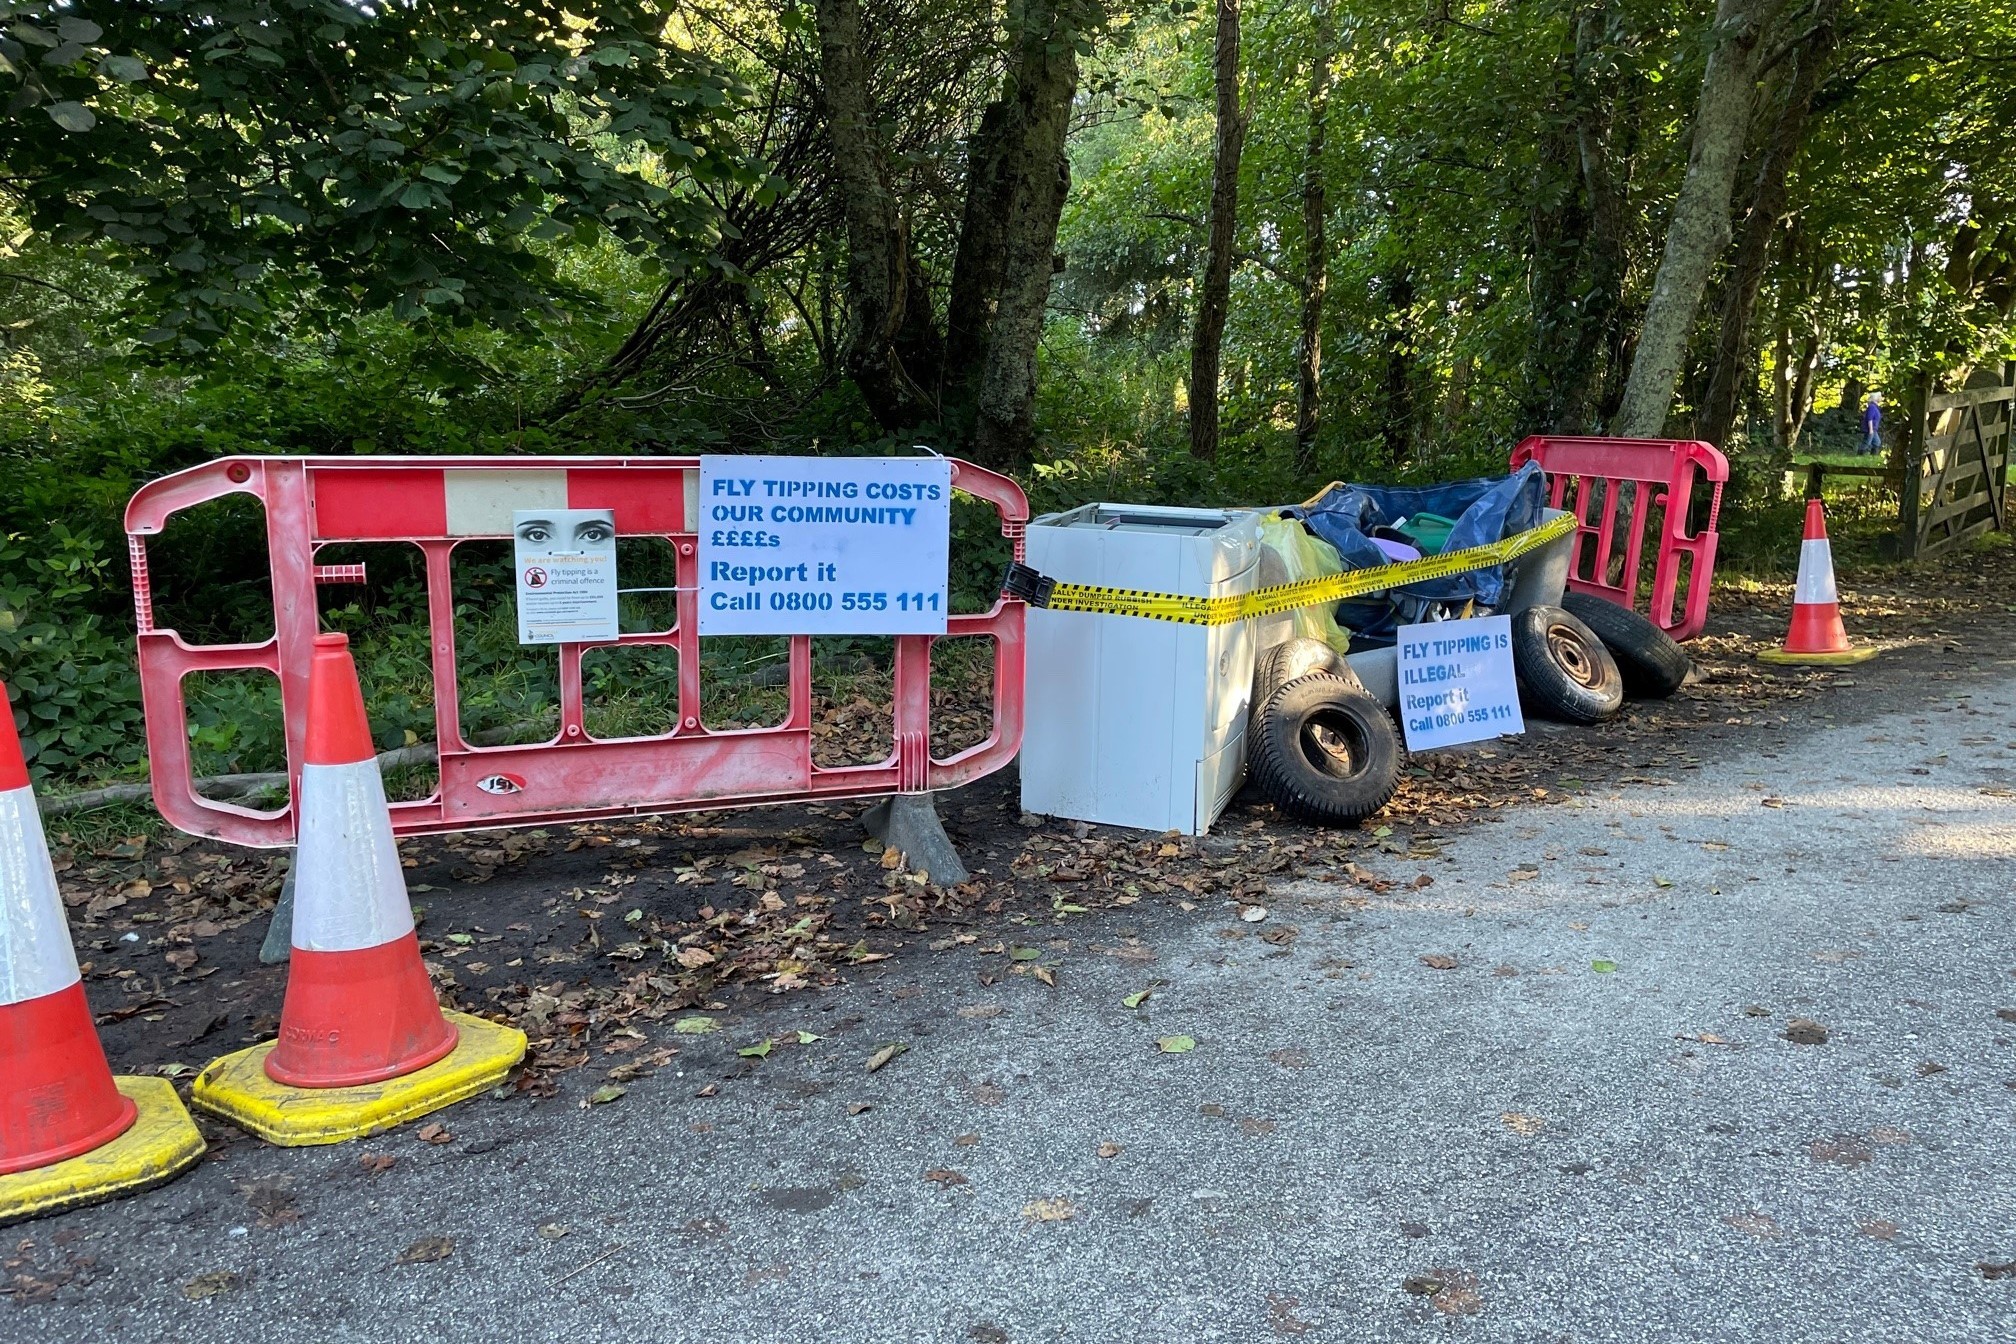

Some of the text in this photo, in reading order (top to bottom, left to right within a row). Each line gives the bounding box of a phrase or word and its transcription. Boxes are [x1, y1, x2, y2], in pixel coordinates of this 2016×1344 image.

[713, 480, 940, 500] FLY TIPPING COSTS
[712, 505, 917, 524] OUR COMMUNITY
[712, 531, 780, 547] ££££s
[711, 561, 836, 586] Report it
[710, 592, 939, 610] Call 0800 555 111
[1076, 598, 1138, 610] INVESTIGATION
[1079, 592, 1112, 600] DUMPED
[1182, 602, 1220, 611] ILLEGALLY
[1404, 634, 1508, 660] FLY TIPPING IS
[1404, 664, 1465, 684] ILLEGAL
[1406, 688, 1469, 711] Report it
[1410, 705, 1511, 731] Call 0800 555 111
